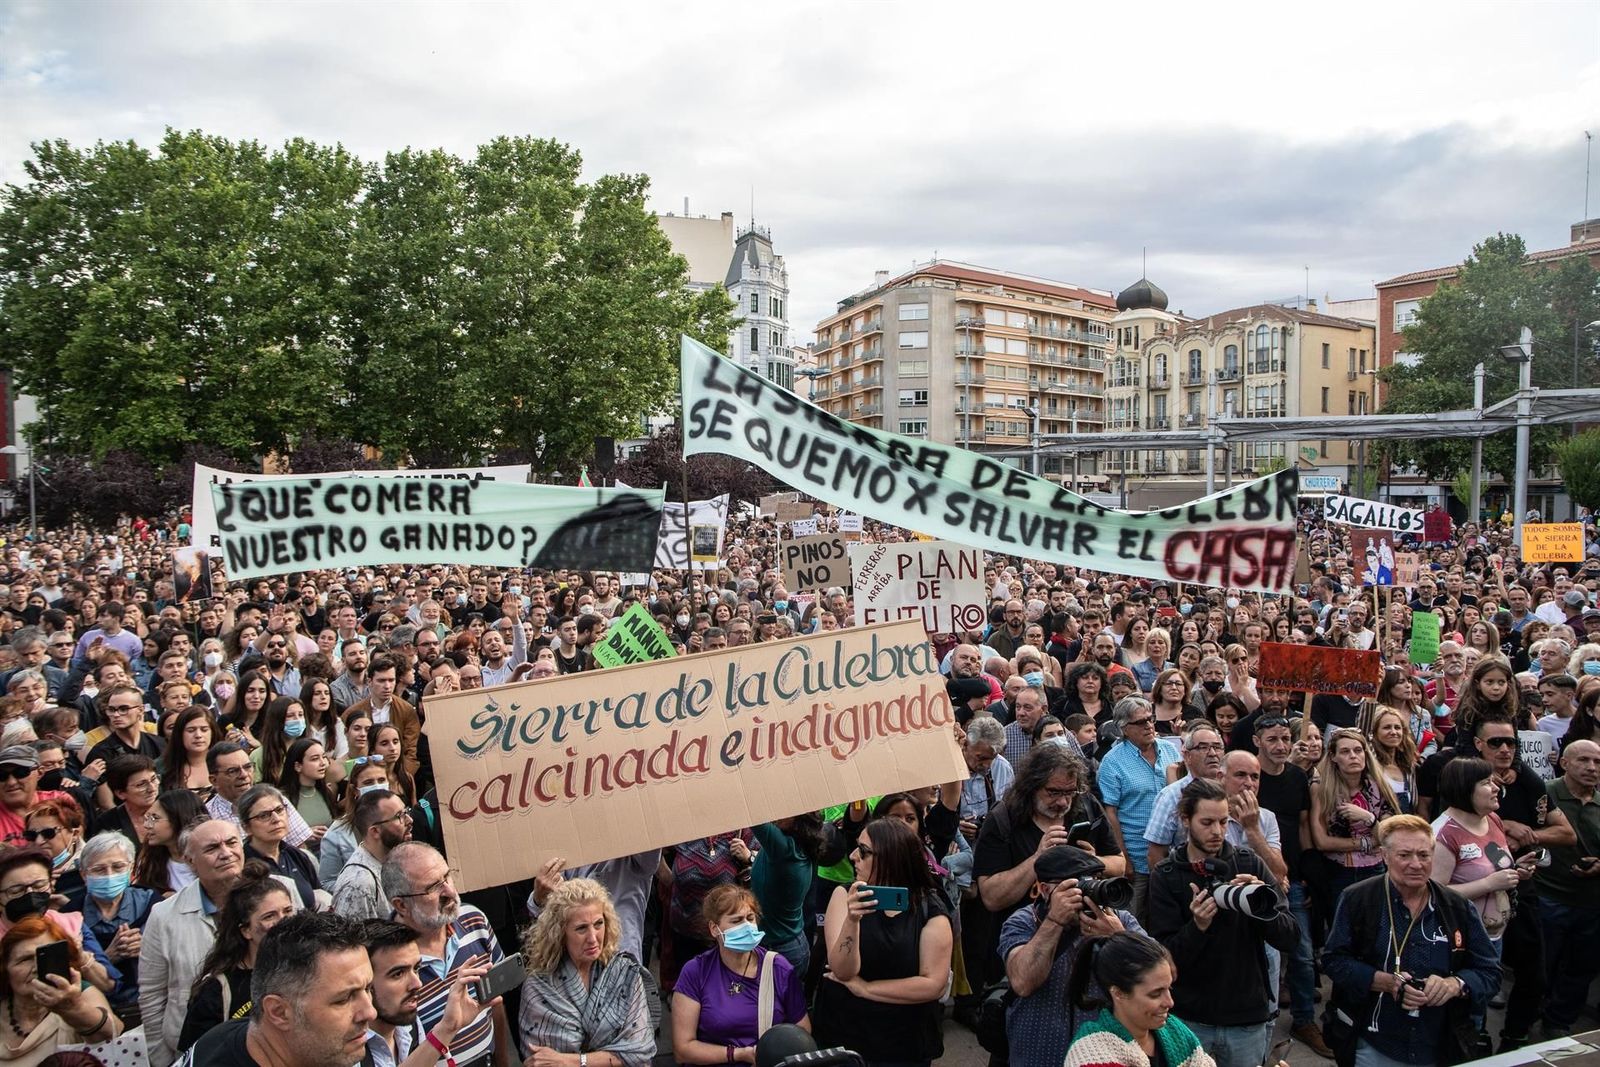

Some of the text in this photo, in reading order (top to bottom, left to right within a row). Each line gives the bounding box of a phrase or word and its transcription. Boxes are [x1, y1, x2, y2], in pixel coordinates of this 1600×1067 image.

[689, 398, 738, 441] SE
[903, 476, 938, 515] X
[943, 491, 1098, 556] SALVAR
[1118, 528, 1156, 561] EL
[1164, 527, 1297, 592] CASA
[969, 459, 1039, 500] DE
[1325, 496, 1425, 531] SAGALLOS
[225, 522, 537, 573] NUESTRO GANADO?
[1544, 534, 1578, 542] SIERRA
[1554, 543, 1567, 551] LA
[854, 544, 887, 591] FERRERAS
[897, 549, 977, 580] PLAN
[1531, 552, 1574, 560] CULEBRA
[796, 565, 831, 589] NO
[917, 580, 941, 600] DE
[456, 632, 938, 755] Sierra de la Culebra
[449, 684, 954, 820] calcinada e indignada
